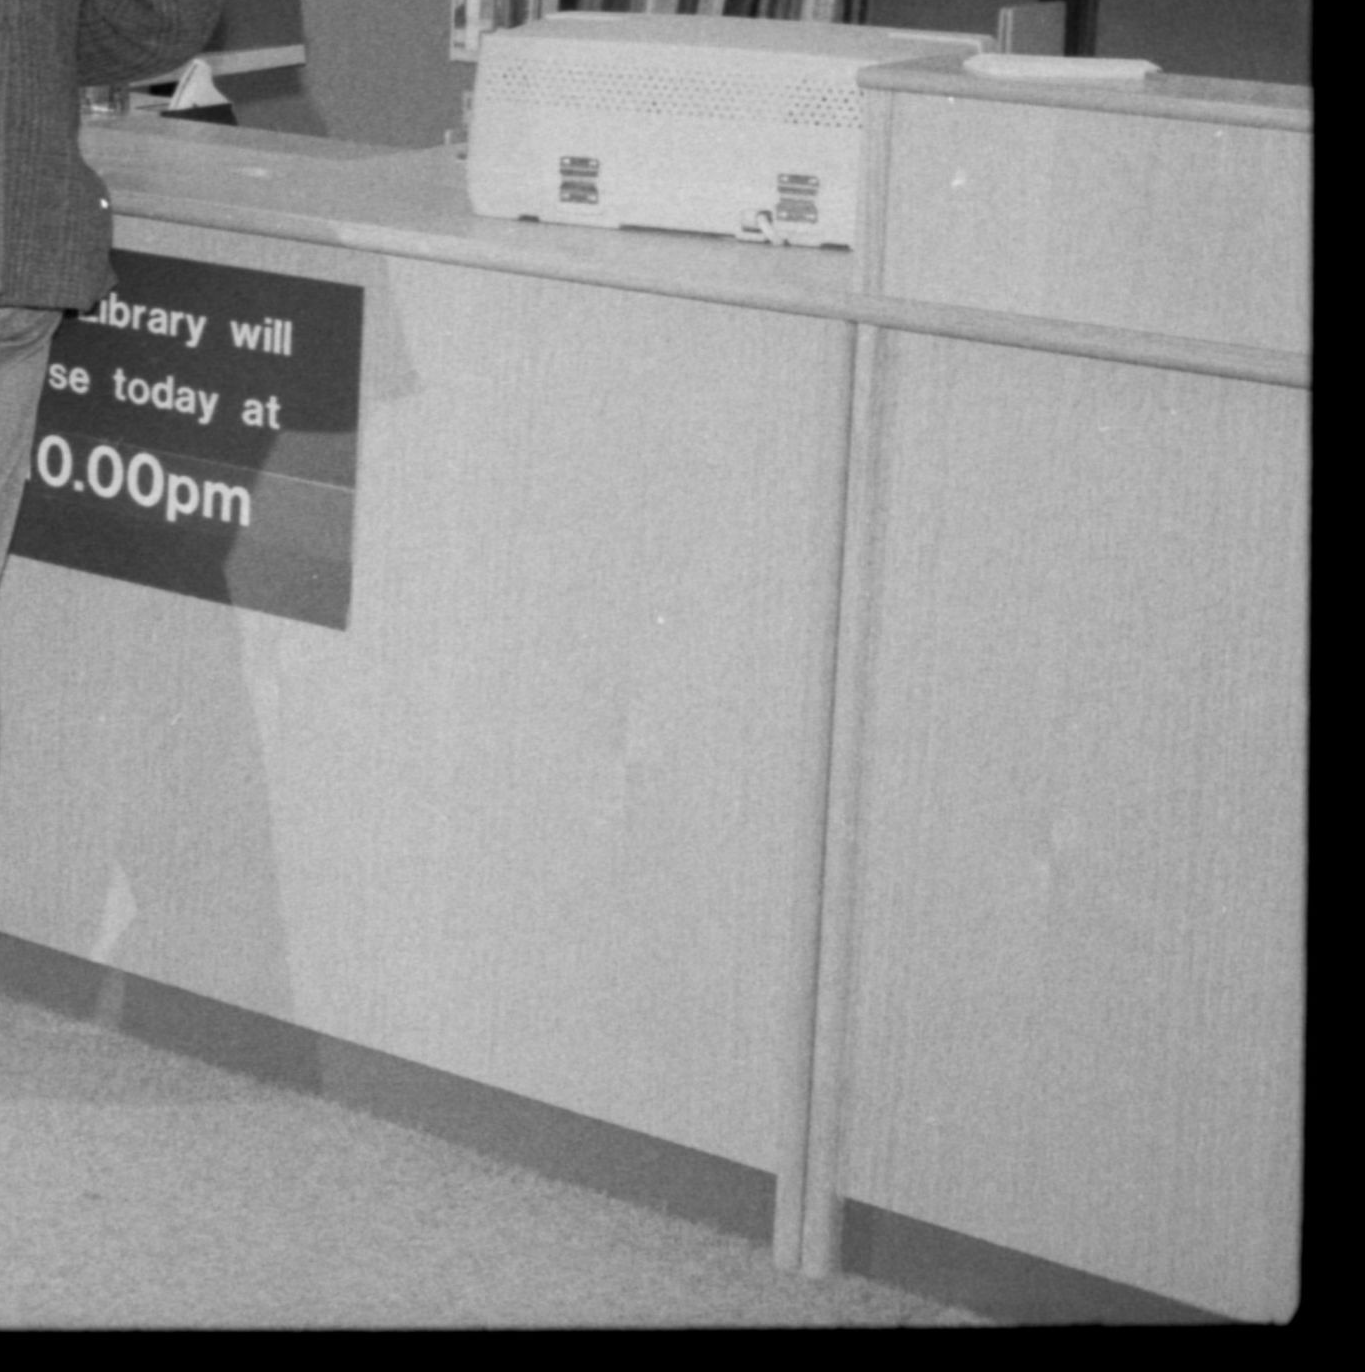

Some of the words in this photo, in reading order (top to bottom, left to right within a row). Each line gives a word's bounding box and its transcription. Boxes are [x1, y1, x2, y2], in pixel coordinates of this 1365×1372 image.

[230, 318, 294, 357] will
[113, 368, 219, 425] today
[241, 395, 281, 430] at
[35, 434, 252, 527] 0.00pm
